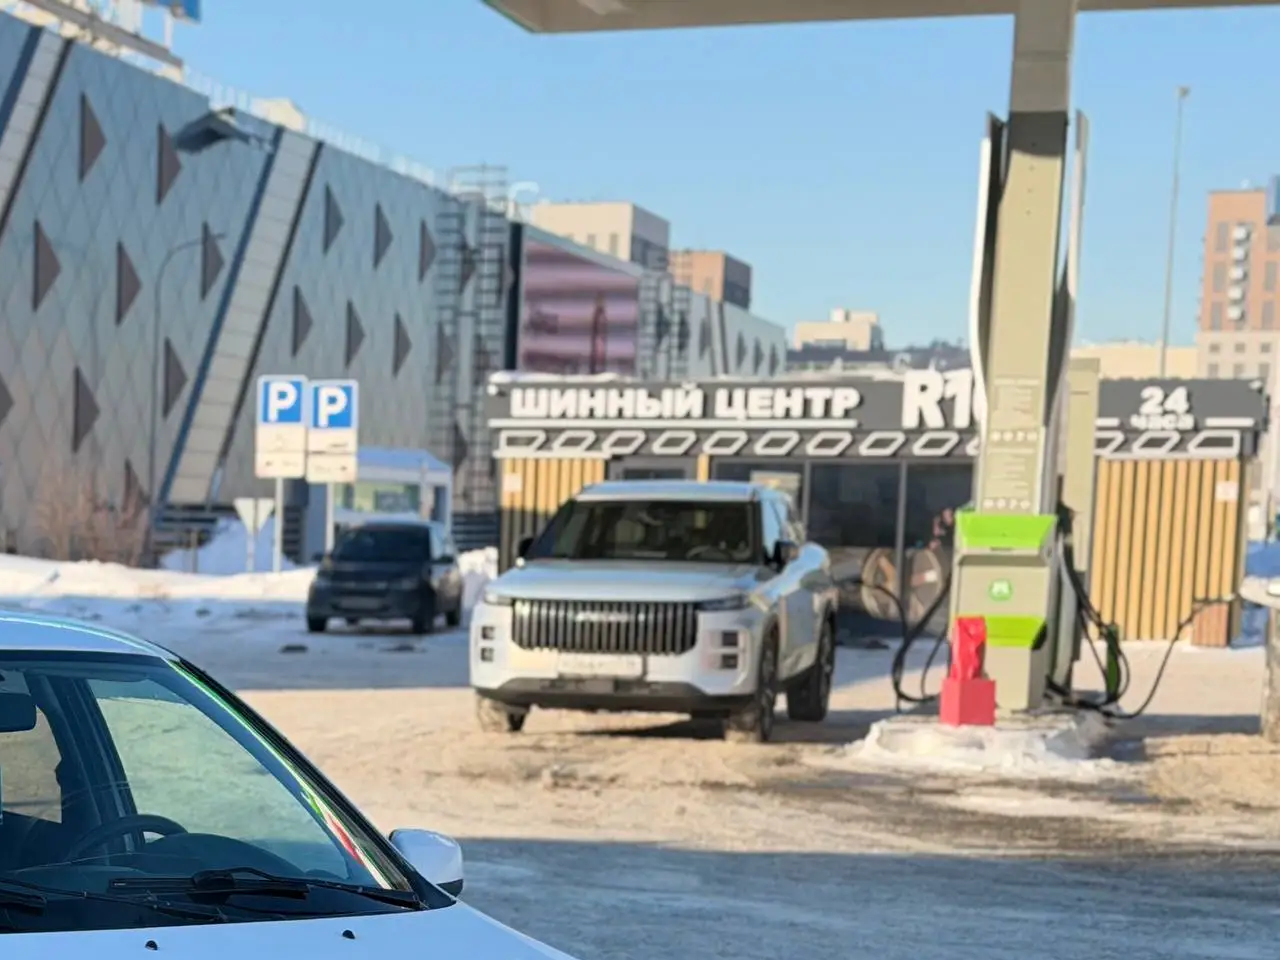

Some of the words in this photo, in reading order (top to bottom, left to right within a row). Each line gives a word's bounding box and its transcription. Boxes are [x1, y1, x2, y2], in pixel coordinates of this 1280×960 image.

[268, 381, 297, 423] P
[318, 386, 348, 428] P
[510, 381, 705, 419] ШИННЫЙ
[714, 387, 861, 421] ЦЕНТР
[1139, 385, 1189, 415] 24
